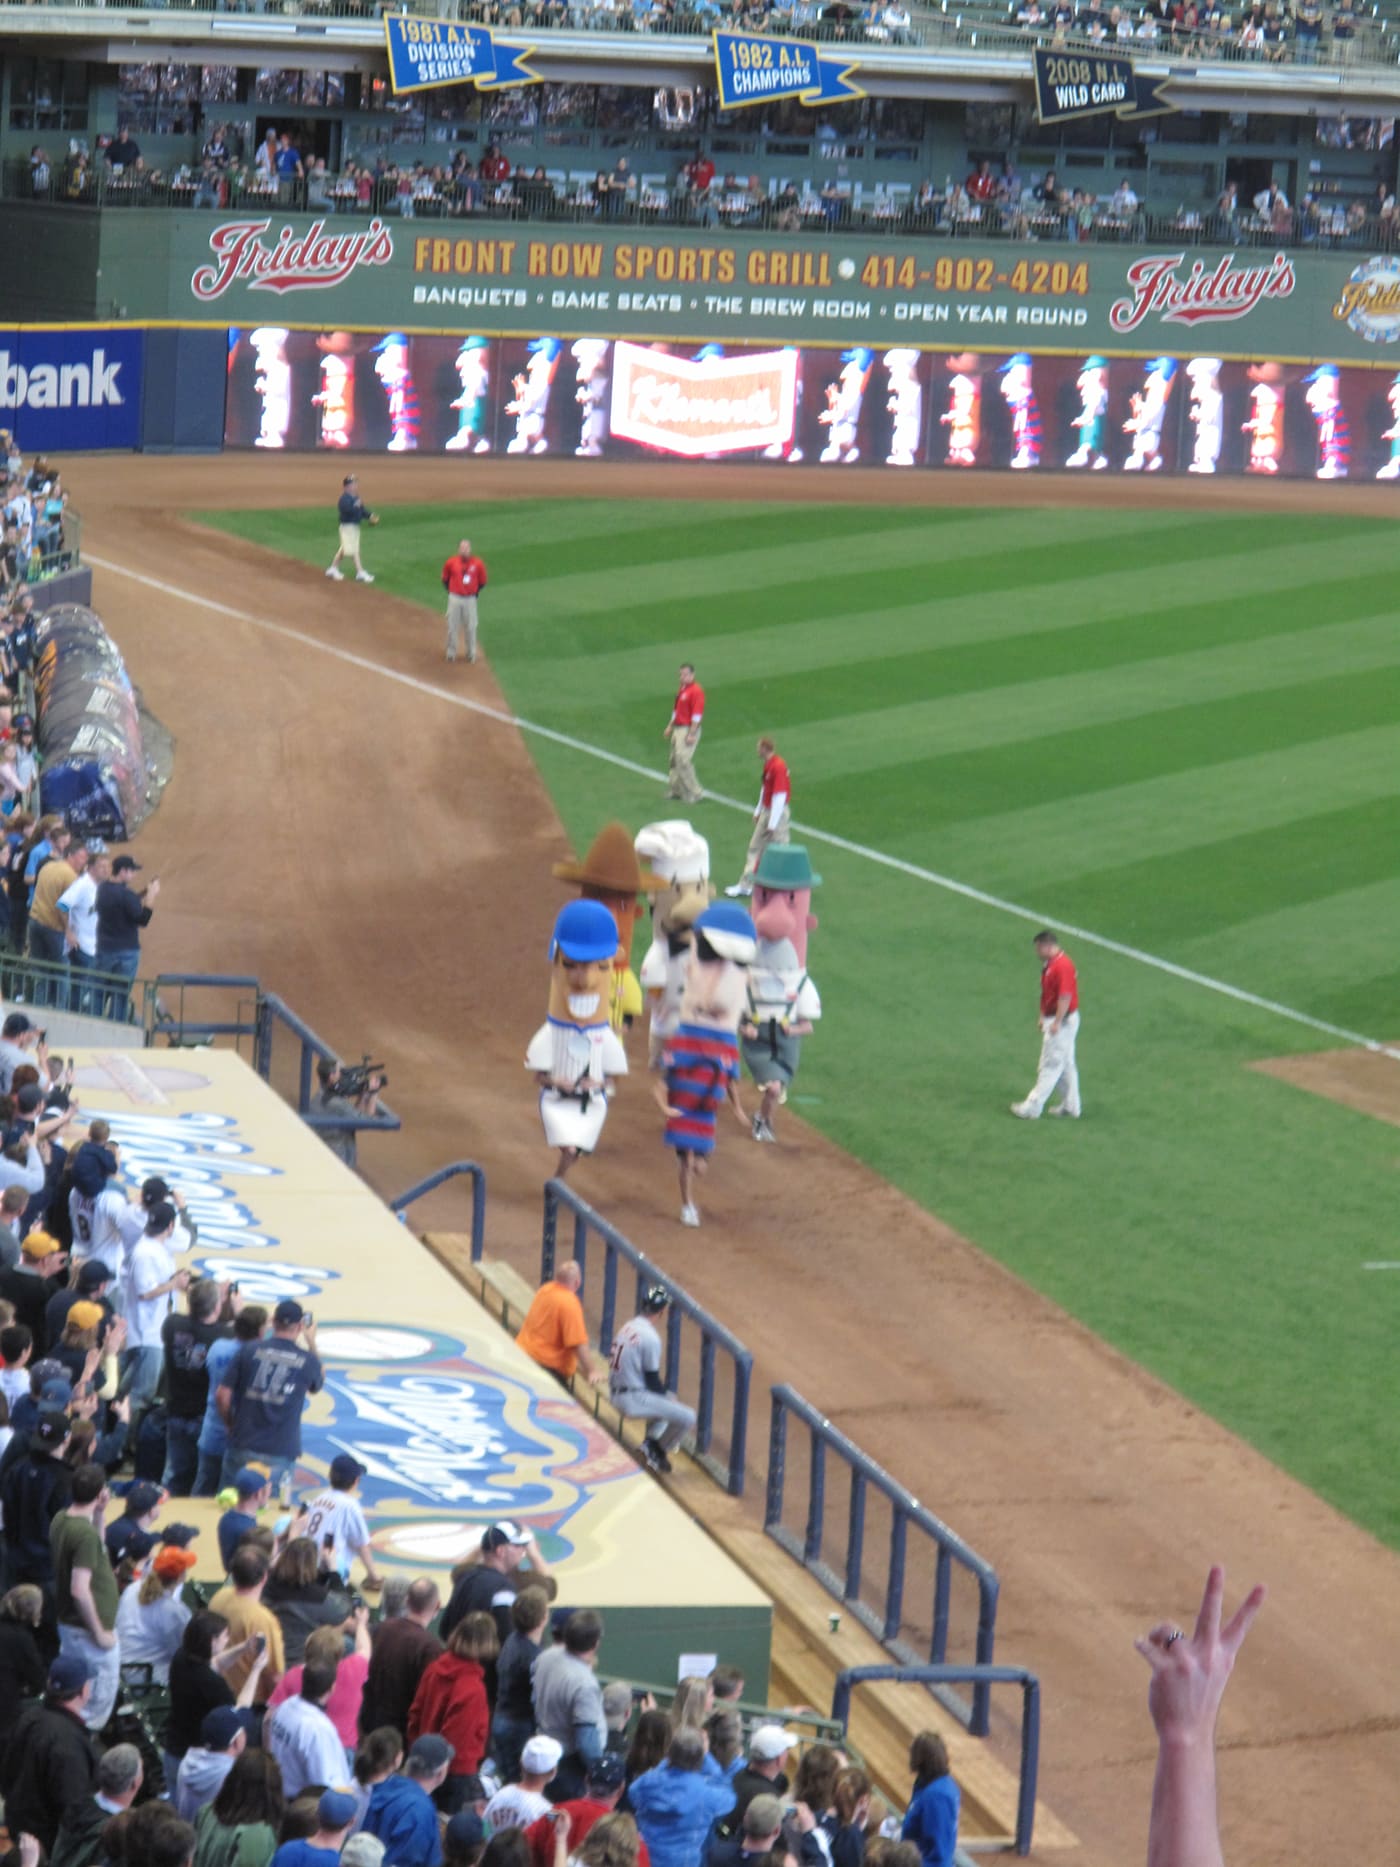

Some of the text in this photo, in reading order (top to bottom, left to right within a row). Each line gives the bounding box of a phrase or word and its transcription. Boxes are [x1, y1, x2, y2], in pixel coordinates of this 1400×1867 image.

[398, 20, 481, 46] 1981 A.L.
[408, 42, 476, 63] DIVISION
[730, 40, 811, 69] 1982 A.L.
[418, 59, 472, 82] SERIES
[732, 67, 812, 95] CHAMPIONS
[1046, 57, 1091, 86] 2008
[1055, 81, 1126, 110] WILD CARD
[191, 216, 393, 301] Friday's
[414, 236, 1090, 296] FRONT ROW SPORTS GRILL 414-902-4204
[413, 286, 1088, 326] BANQUETS GAME SEATS THE BREW ROOM OPEN YEAR ROUND
[1109, 251, 1296, 333] Friday's
[0, 348, 123, 408] bank
[325, 1376, 508, 1455] Miller
[326, 1432, 516, 1504] Park
[308, 1511, 323, 1536] 8
